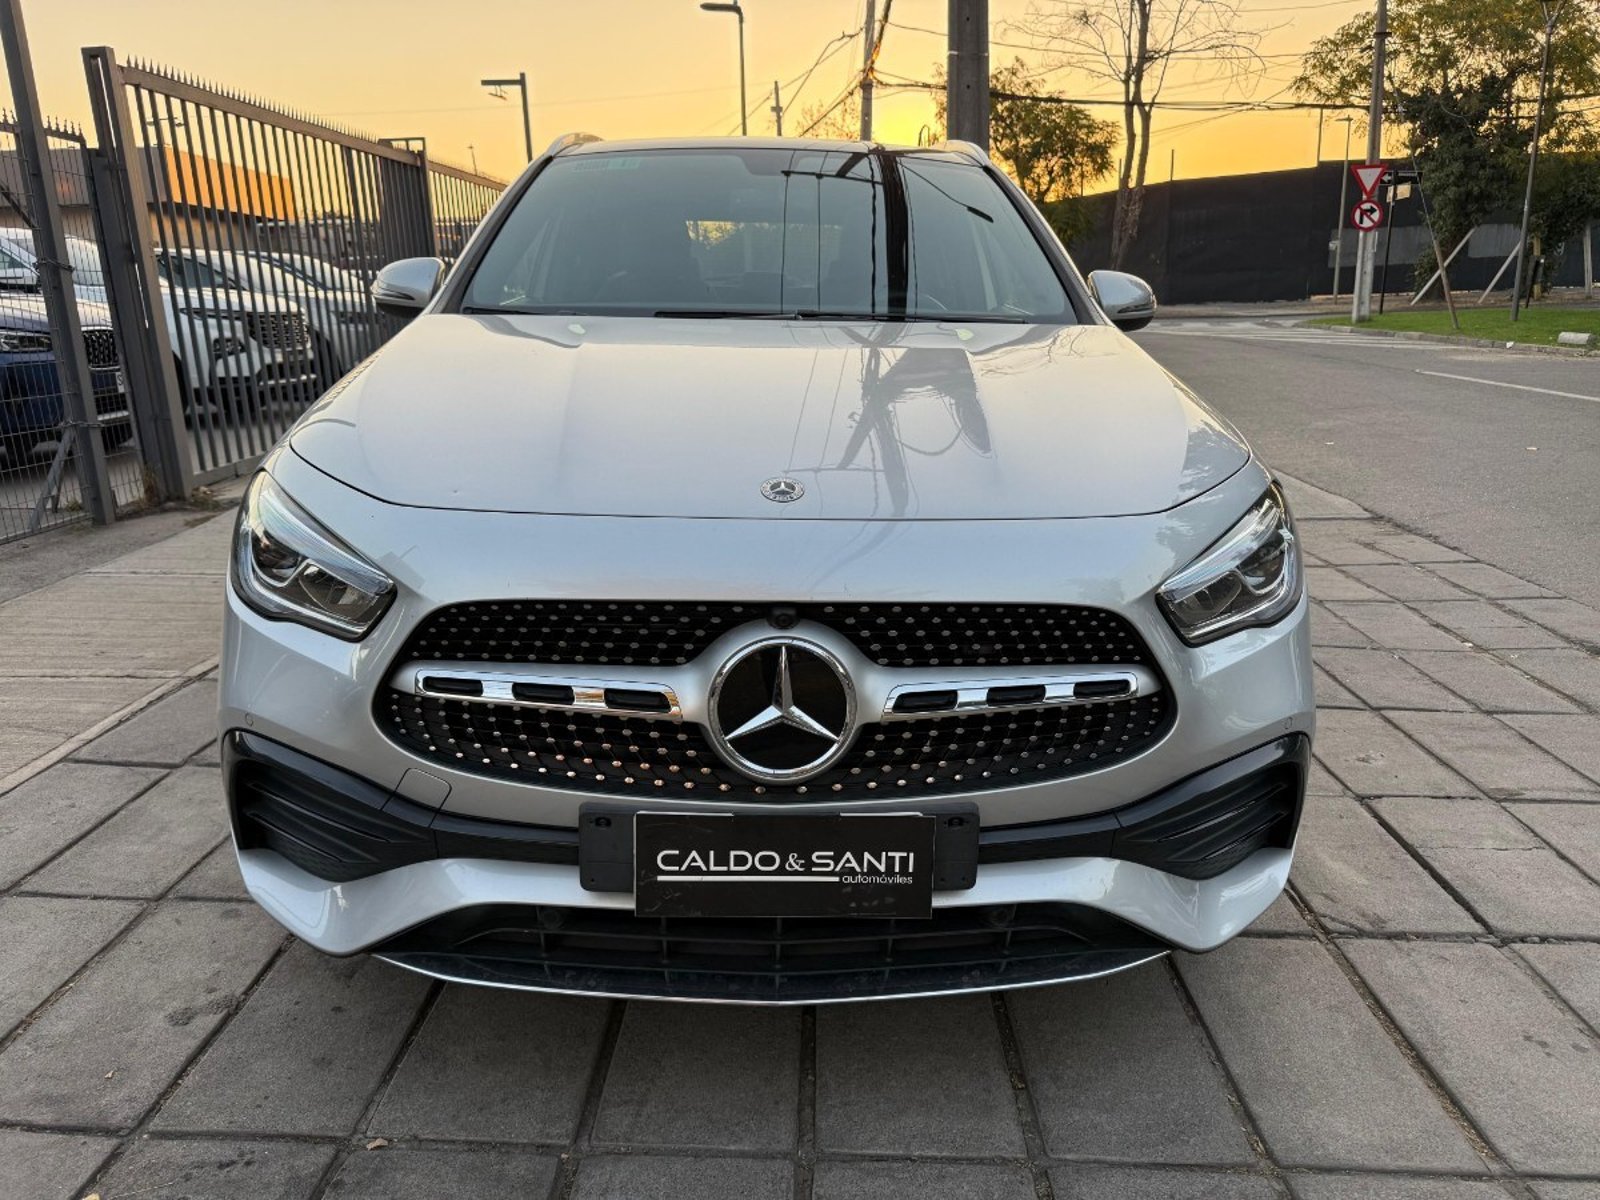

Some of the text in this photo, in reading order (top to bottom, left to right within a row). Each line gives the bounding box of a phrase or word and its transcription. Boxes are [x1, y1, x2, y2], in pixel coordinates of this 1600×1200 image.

[656, 849, 781, 872] CALDO
[811, 851, 915, 873] SANTI
[842, 873, 913, 885] automóviles
